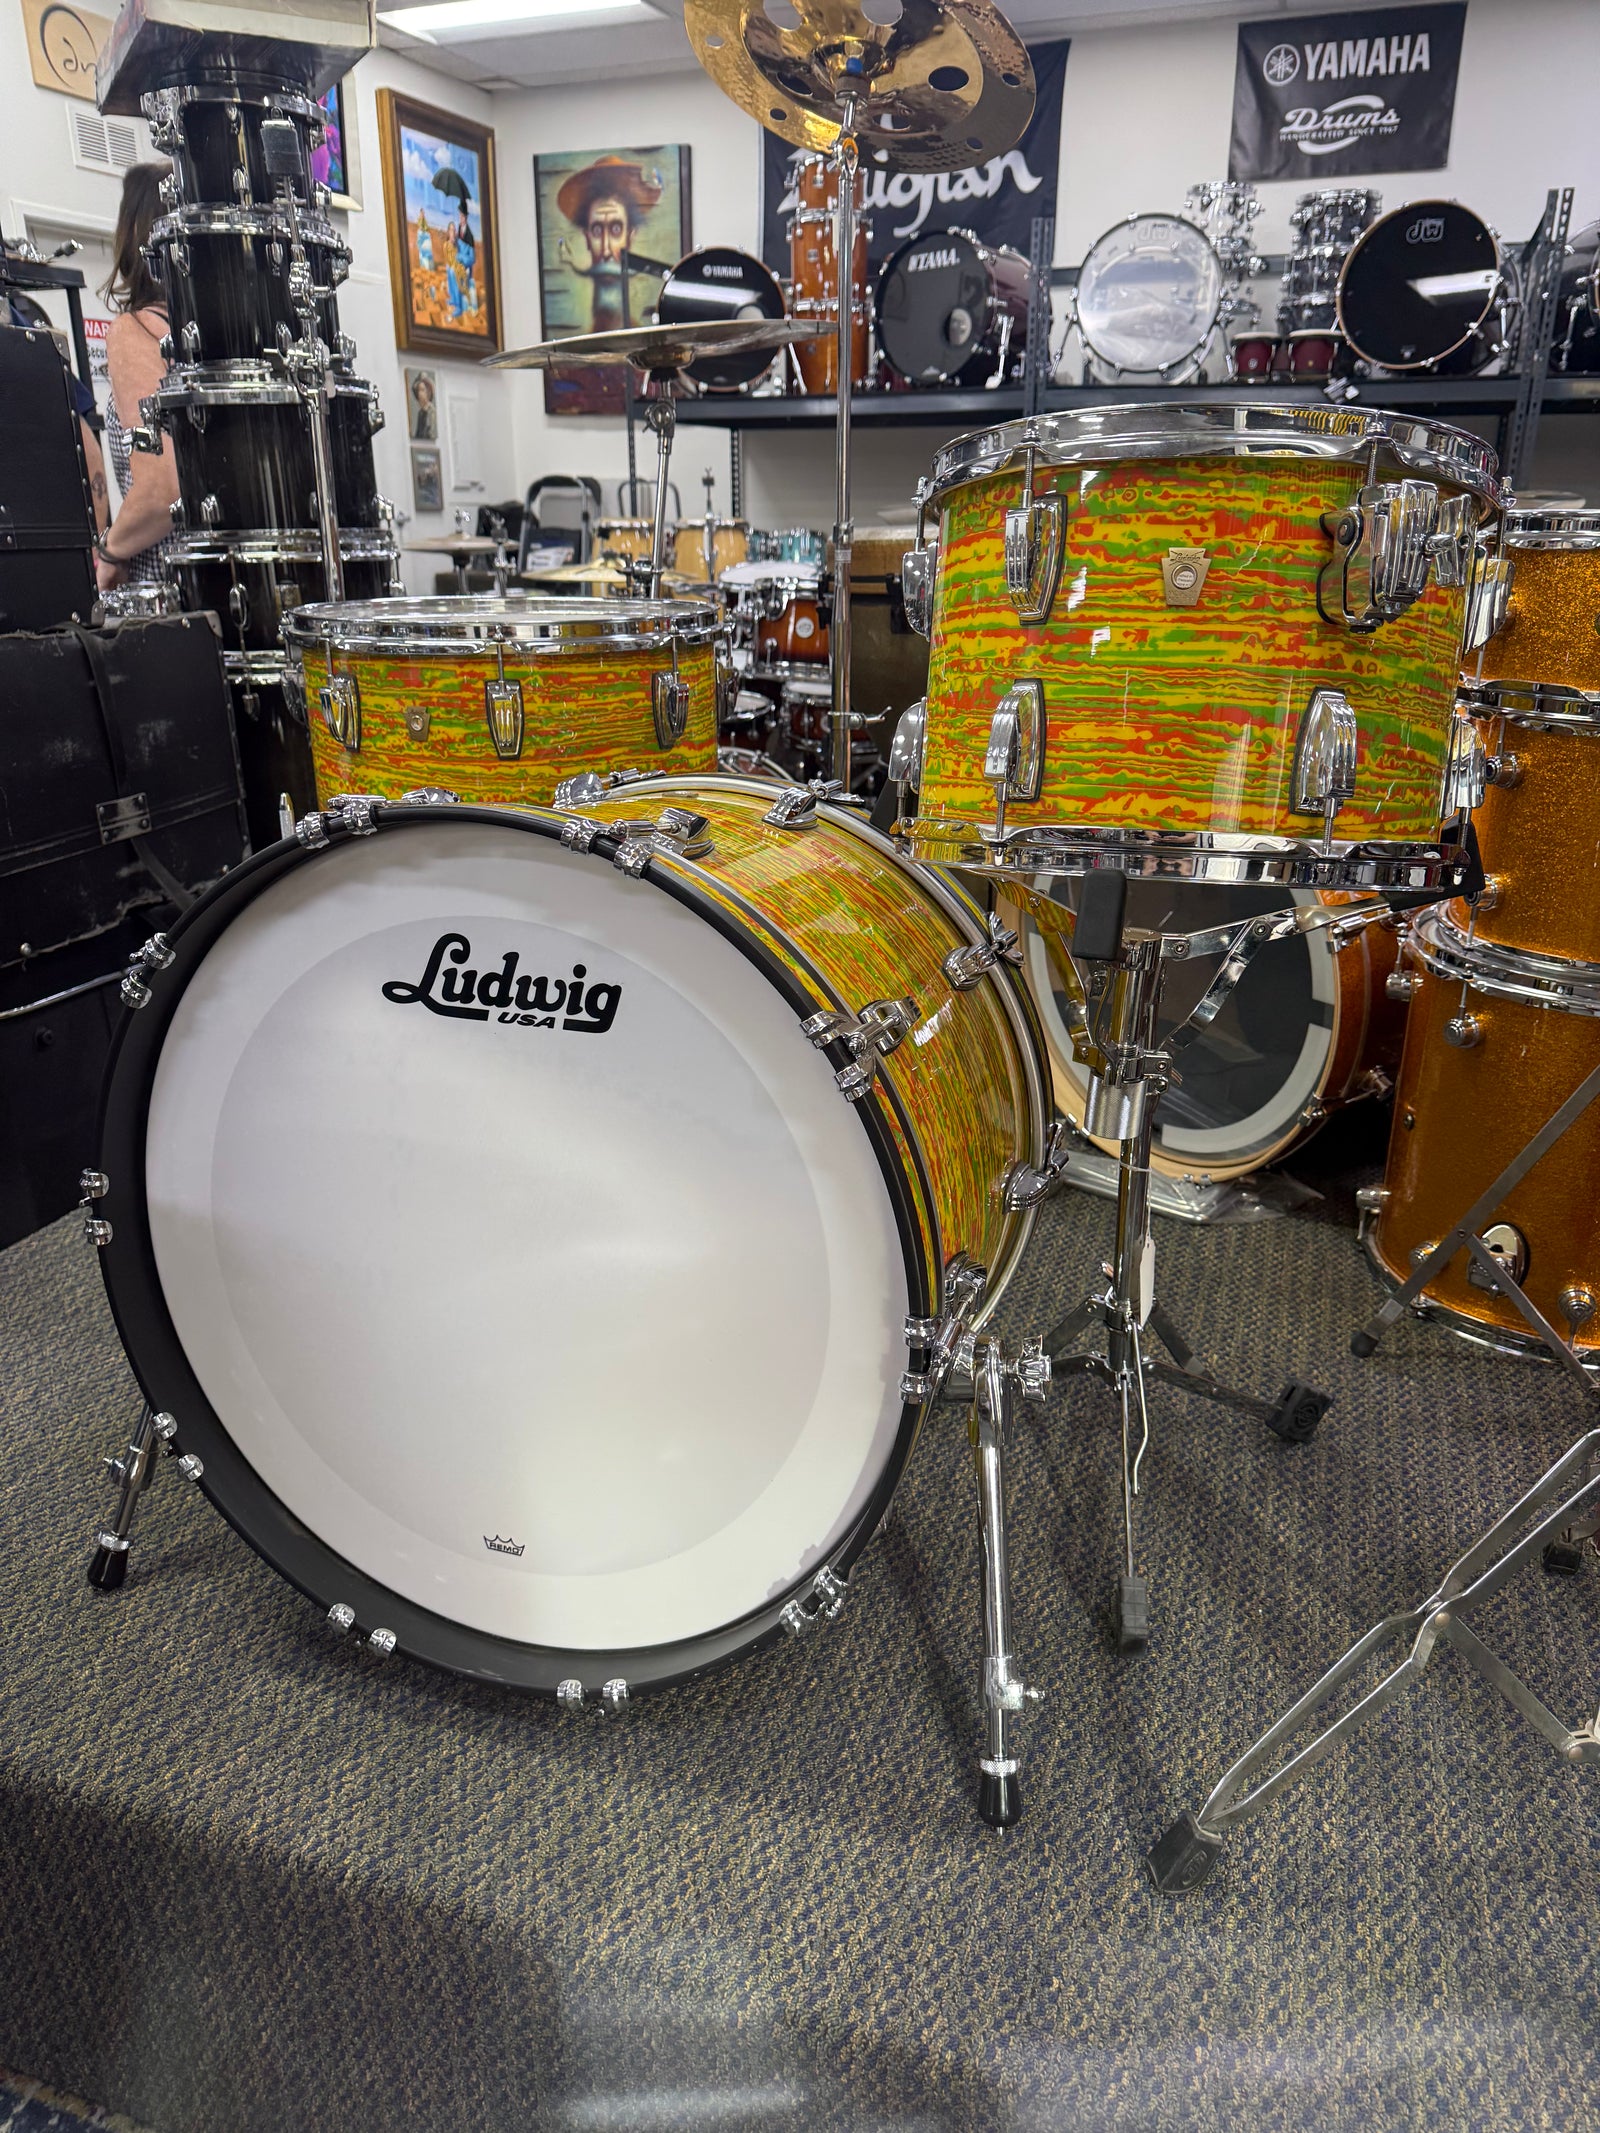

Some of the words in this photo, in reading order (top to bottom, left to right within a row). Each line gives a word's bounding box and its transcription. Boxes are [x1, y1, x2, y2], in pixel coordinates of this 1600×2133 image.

[1304, 33, 1430, 82] YAMAHA
[1279, 107, 1401, 133] Drums
[381, 932, 622, 1034] Ludwig
[497, 1011, 556, 1029] USA
[489, 1541, 521, 1554] REMO
